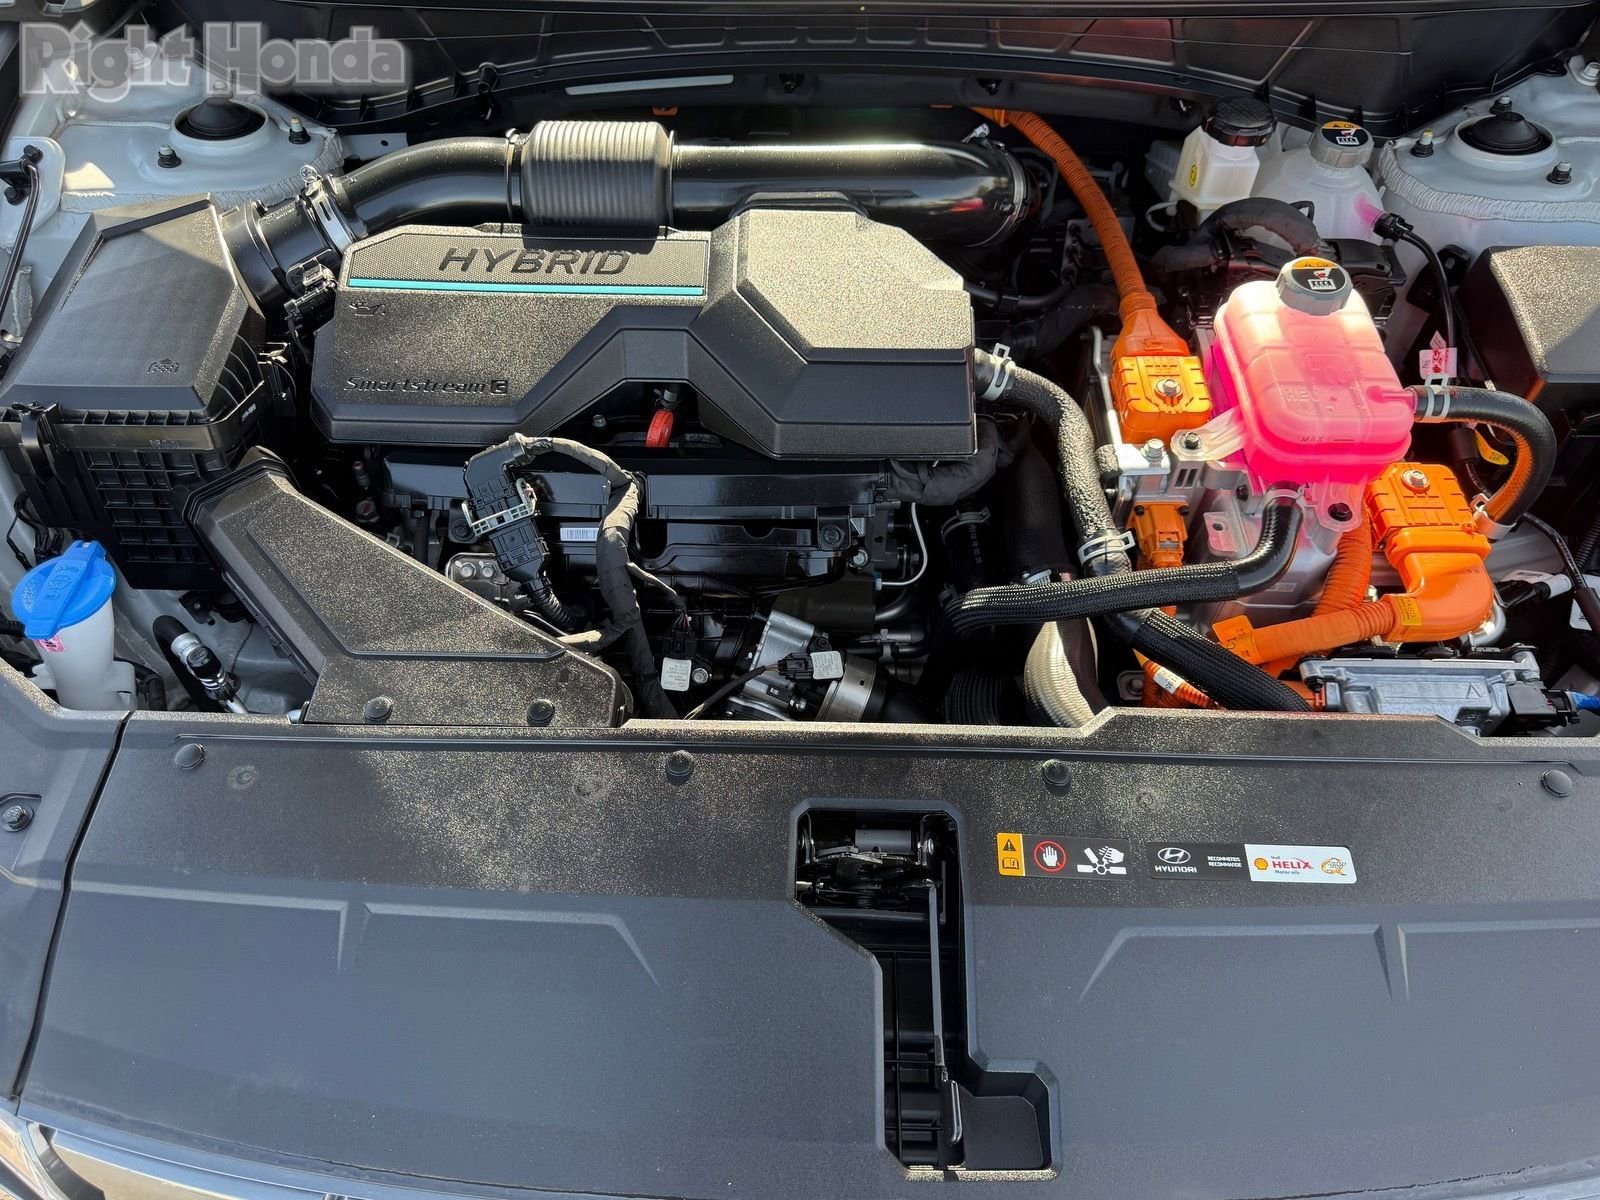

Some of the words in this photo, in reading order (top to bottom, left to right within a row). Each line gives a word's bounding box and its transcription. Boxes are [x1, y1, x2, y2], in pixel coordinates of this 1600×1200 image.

[438, 247, 631, 275] HYBRID
[344, 377, 487, 394] Smartstream
[1154, 865, 1198, 874] HYUNDAI
[1272, 860, 1313, 870] HELIX
